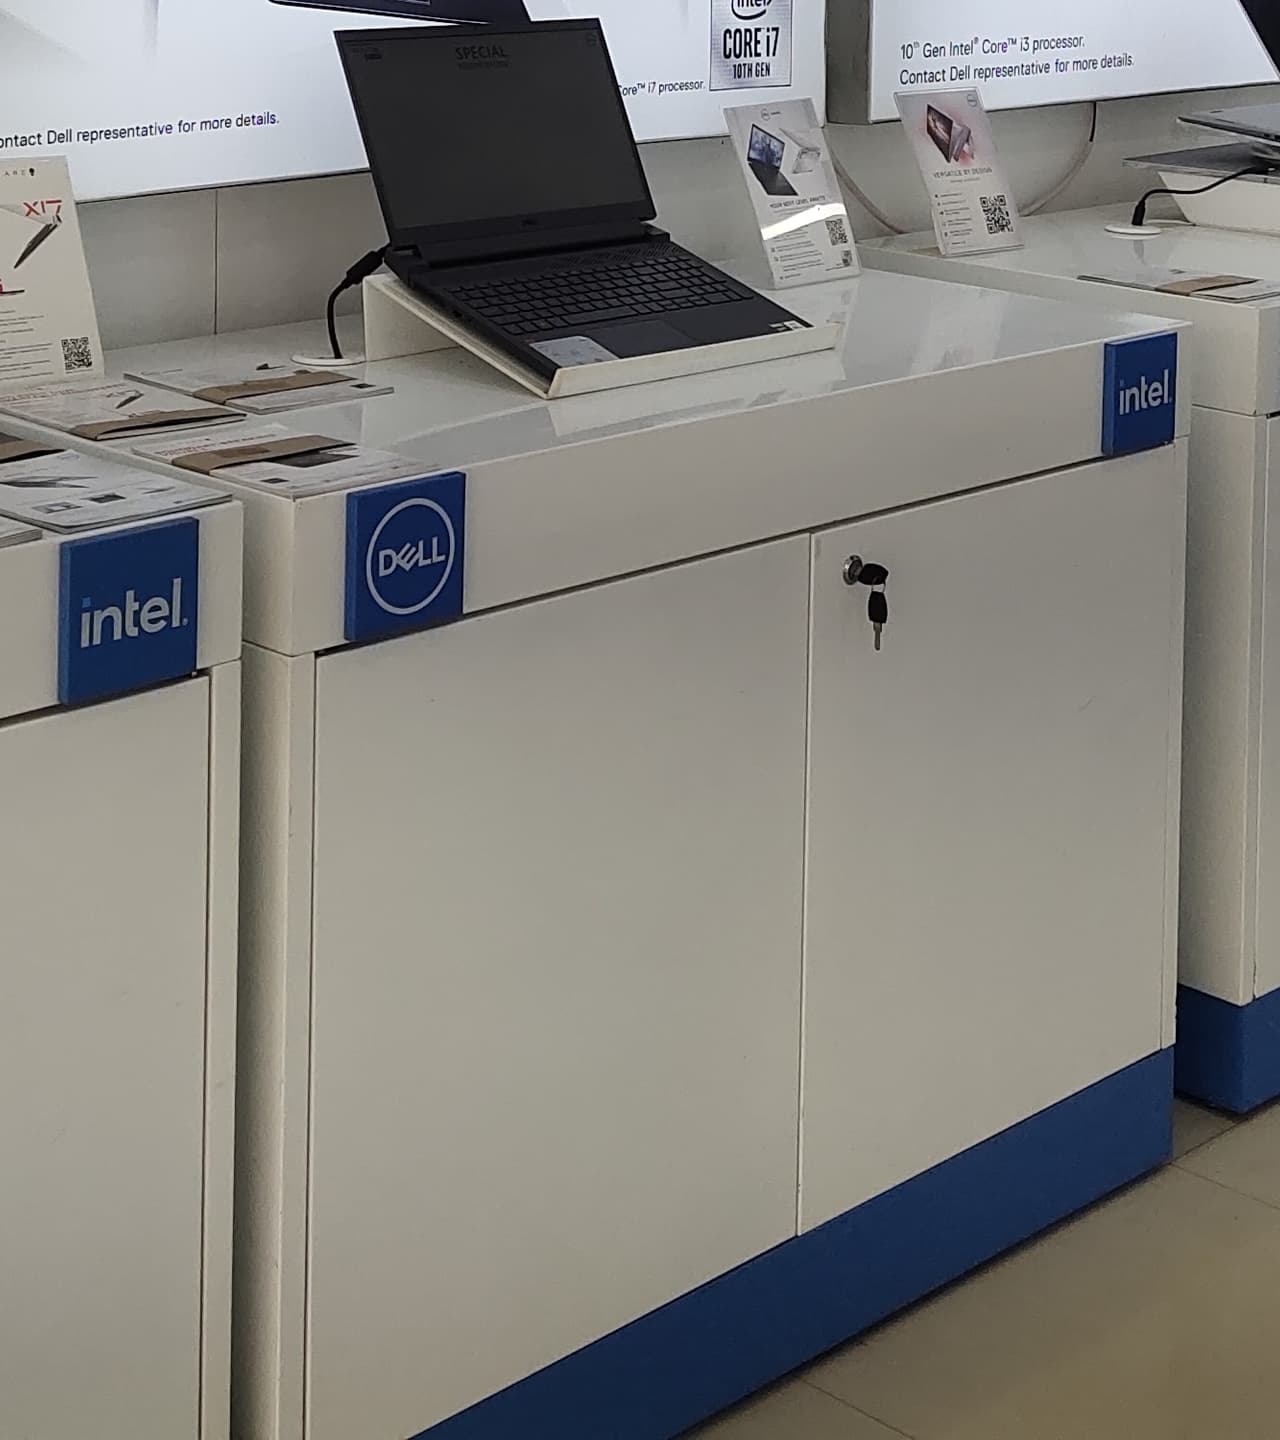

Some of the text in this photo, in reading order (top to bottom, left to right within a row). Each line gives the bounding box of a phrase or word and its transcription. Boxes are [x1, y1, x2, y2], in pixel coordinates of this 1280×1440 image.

[723, 27, 780, 59] CORE i7
[923, 43, 946, 58] Gen
[1020, 37, 1030, 51] i3
[1033, 35, 1085, 54] processor.
[733, 62, 771, 79] 10TH GEN
[899, 53, 1134, 85] Contact Dell representative for more details.
[648, 81, 656, 94] i7
[658, 80, 705, 96] processor.
[47, 128, 73, 144] Dell
[77, 123, 173, 144] representative
[178, 119, 196, 133] for
[200, 117, 232, 131] more
[235, 111, 280, 127] details.
[378, 536, 445, 578] DELL
